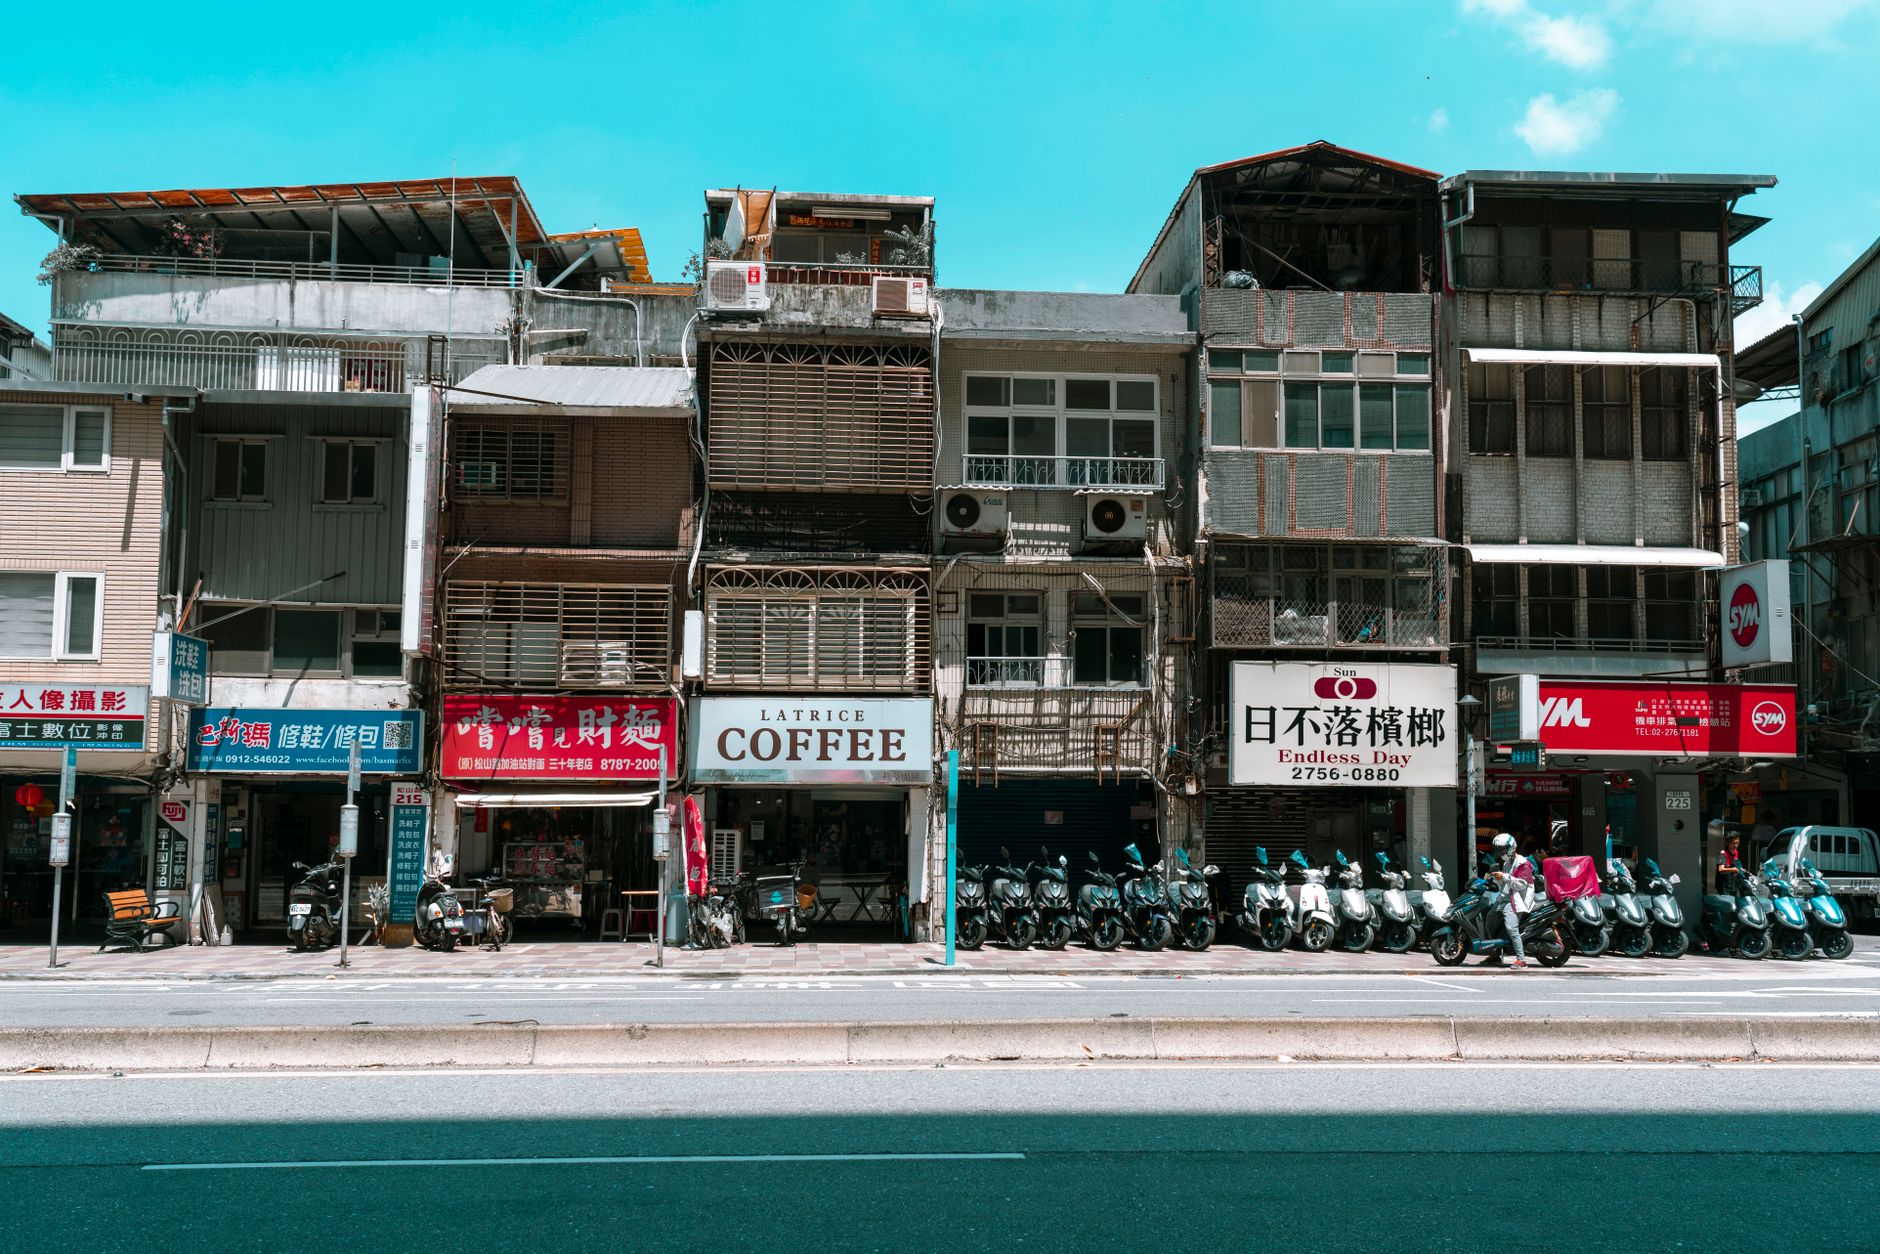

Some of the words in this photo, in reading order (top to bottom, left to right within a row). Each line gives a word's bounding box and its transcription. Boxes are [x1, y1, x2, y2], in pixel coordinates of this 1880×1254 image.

[1729, 601, 1760, 635] SYM
[175, 640, 199, 669] 洗鞋
[1333, 668, 1356, 677] Sun
[178, 670, 202, 698] 洗包
[761, 709, 865, 721] LATRICE
[1635, 716, 1677, 726] 機車排氣
[1699, 717, 1731, 727] 檢驗站
[1753, 711, 1785, 726] SYM
[96, 723, 124, 731] 影像
[196, 716, 271, 750] 巴斯瑪
[1245, 705, 1445, 748] 日不落檳榔
[278, 723, 379, 750] 修鞋/修包
[717, 727, 906, 761] COFFEE
[225, 755, 291, 764] 0912-546022
[549, 757, 593, 771] 三十年老店
[1278, 749, 1360, 764] Endless
[1373, 750, 1412, 768] Day
[1292, 767, 1399, 781] 2756-0880
[396, 794, 422, 803] 215
[1667, 798, 1689, 808] 225
[155, 828, 170, 887] 富士即可拍
[172, 840, 187, 888] 富士軟片
